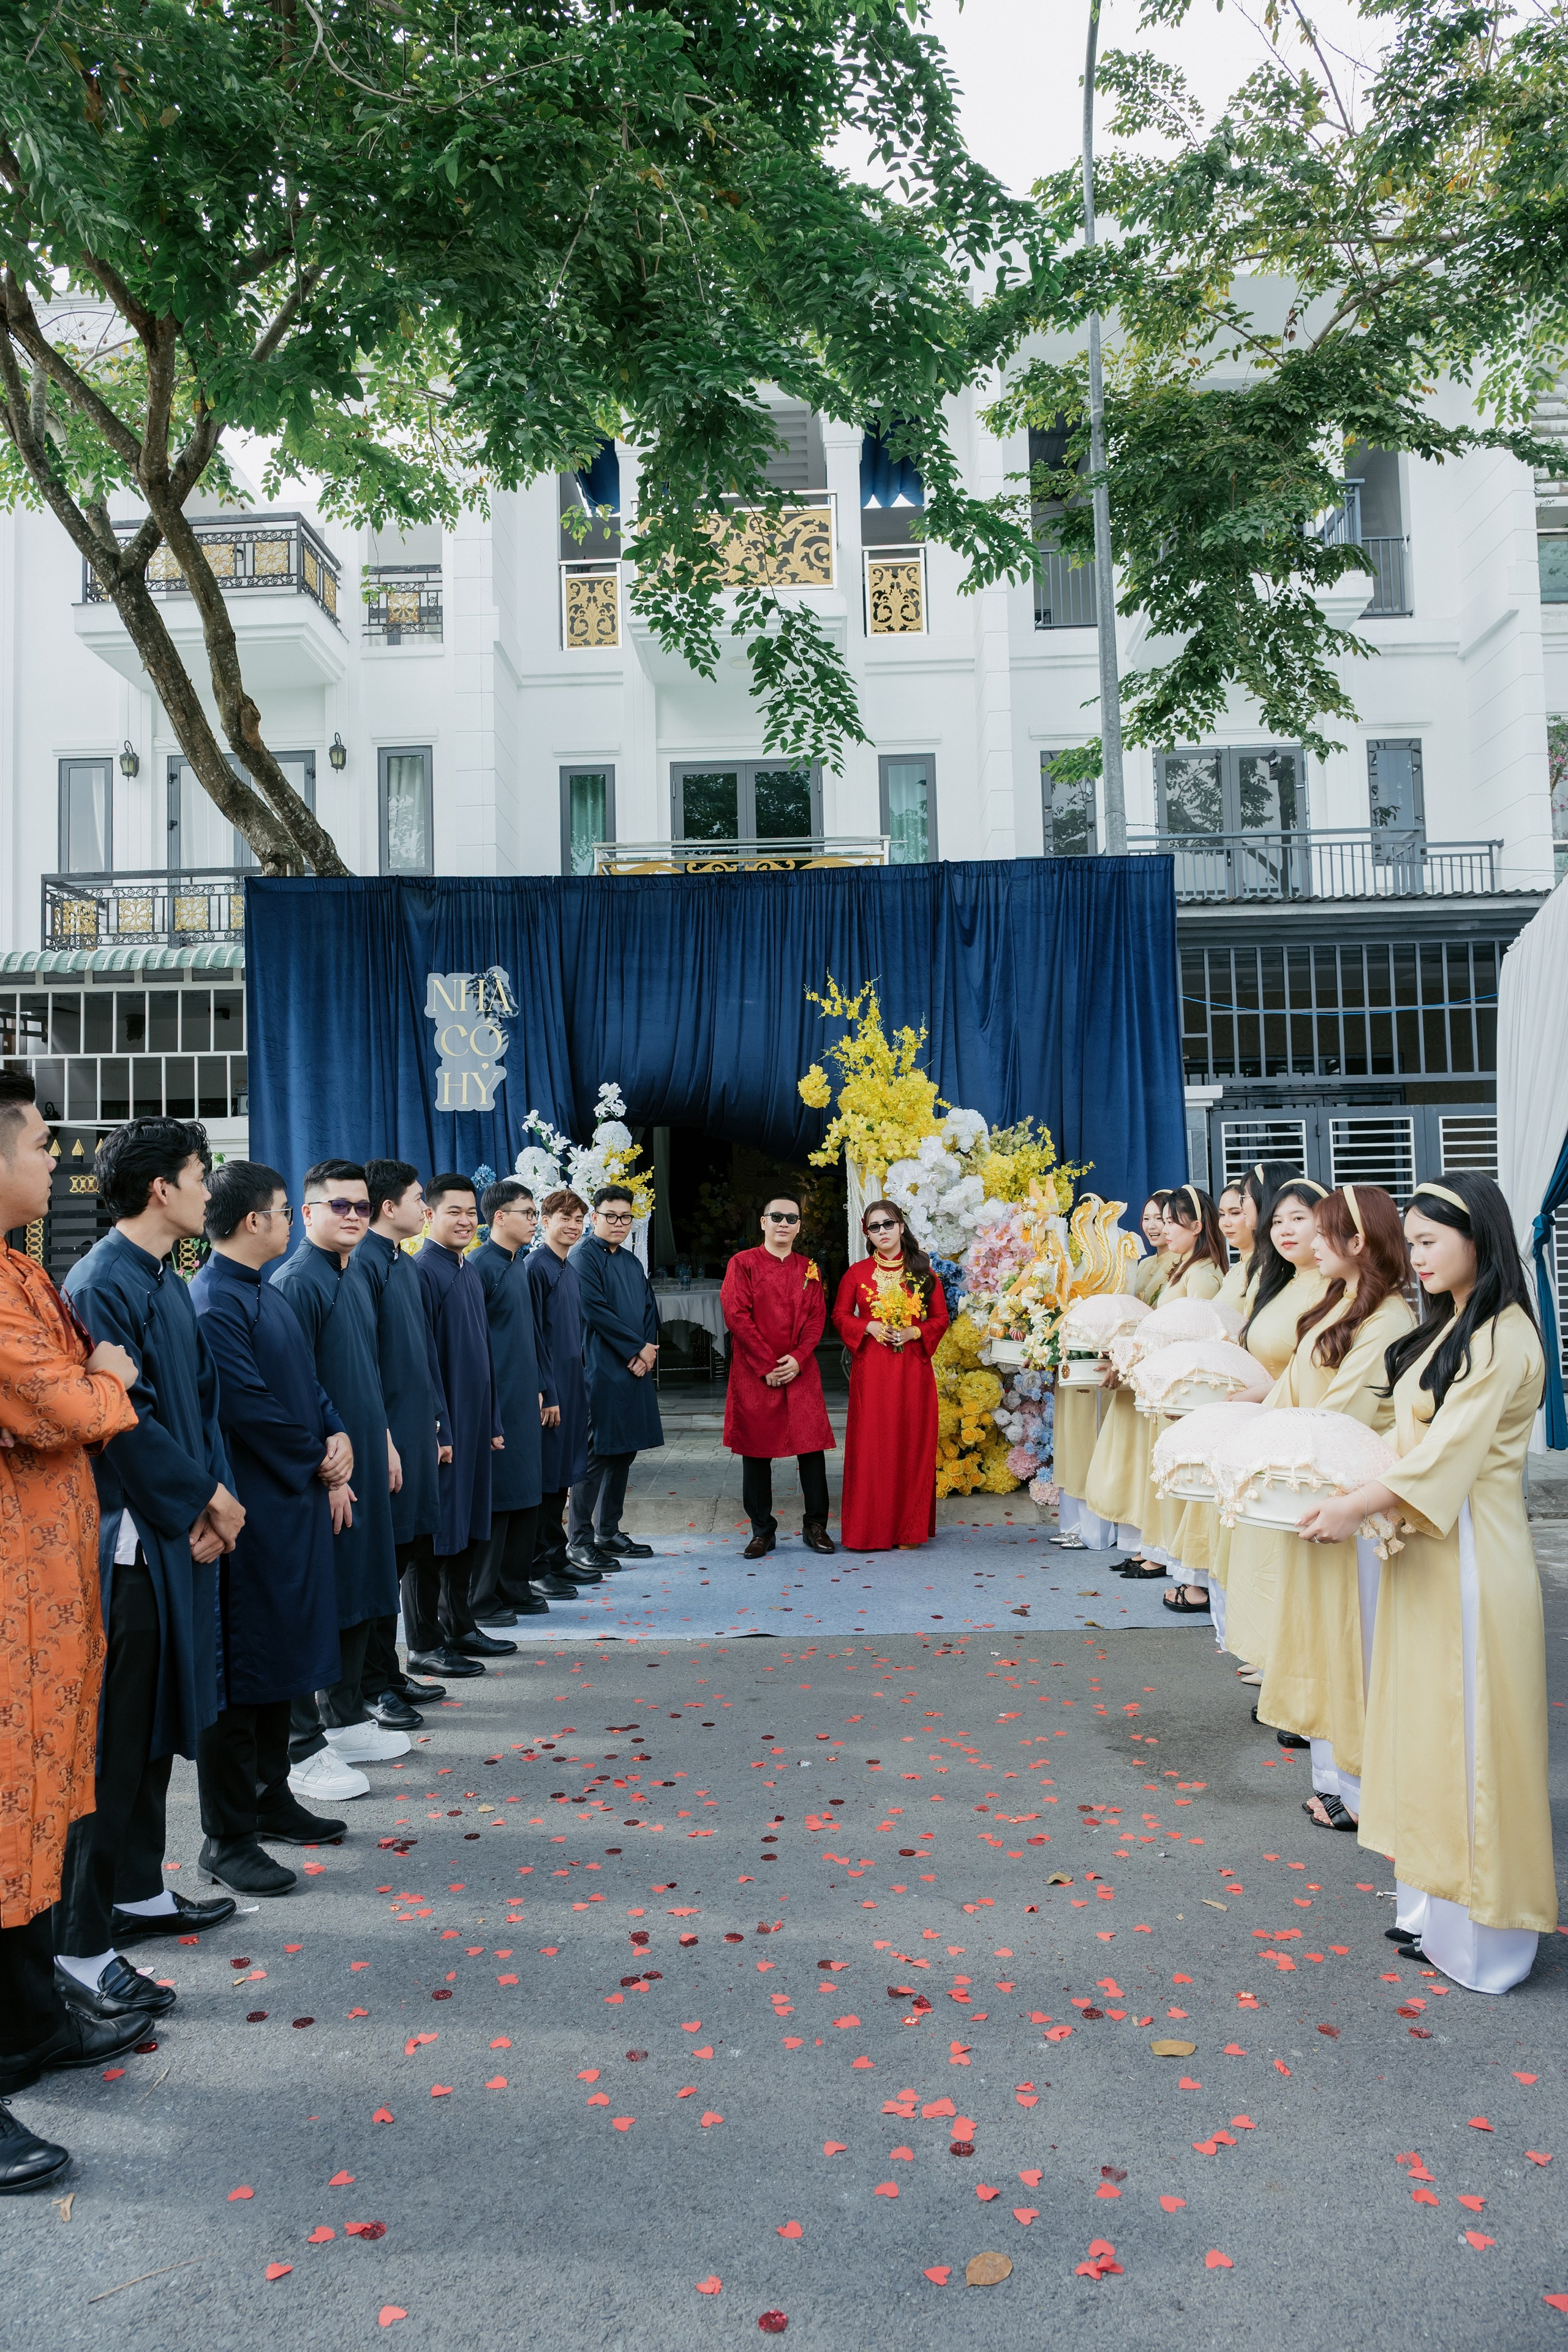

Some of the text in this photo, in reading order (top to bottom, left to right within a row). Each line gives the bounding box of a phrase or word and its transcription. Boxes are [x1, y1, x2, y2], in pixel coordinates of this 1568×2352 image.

[431, 972, 512, 1011] NHÀ
[440, 1017, 502, 1057] CÓ
[442, 1062, 500, 1104] HỶ
